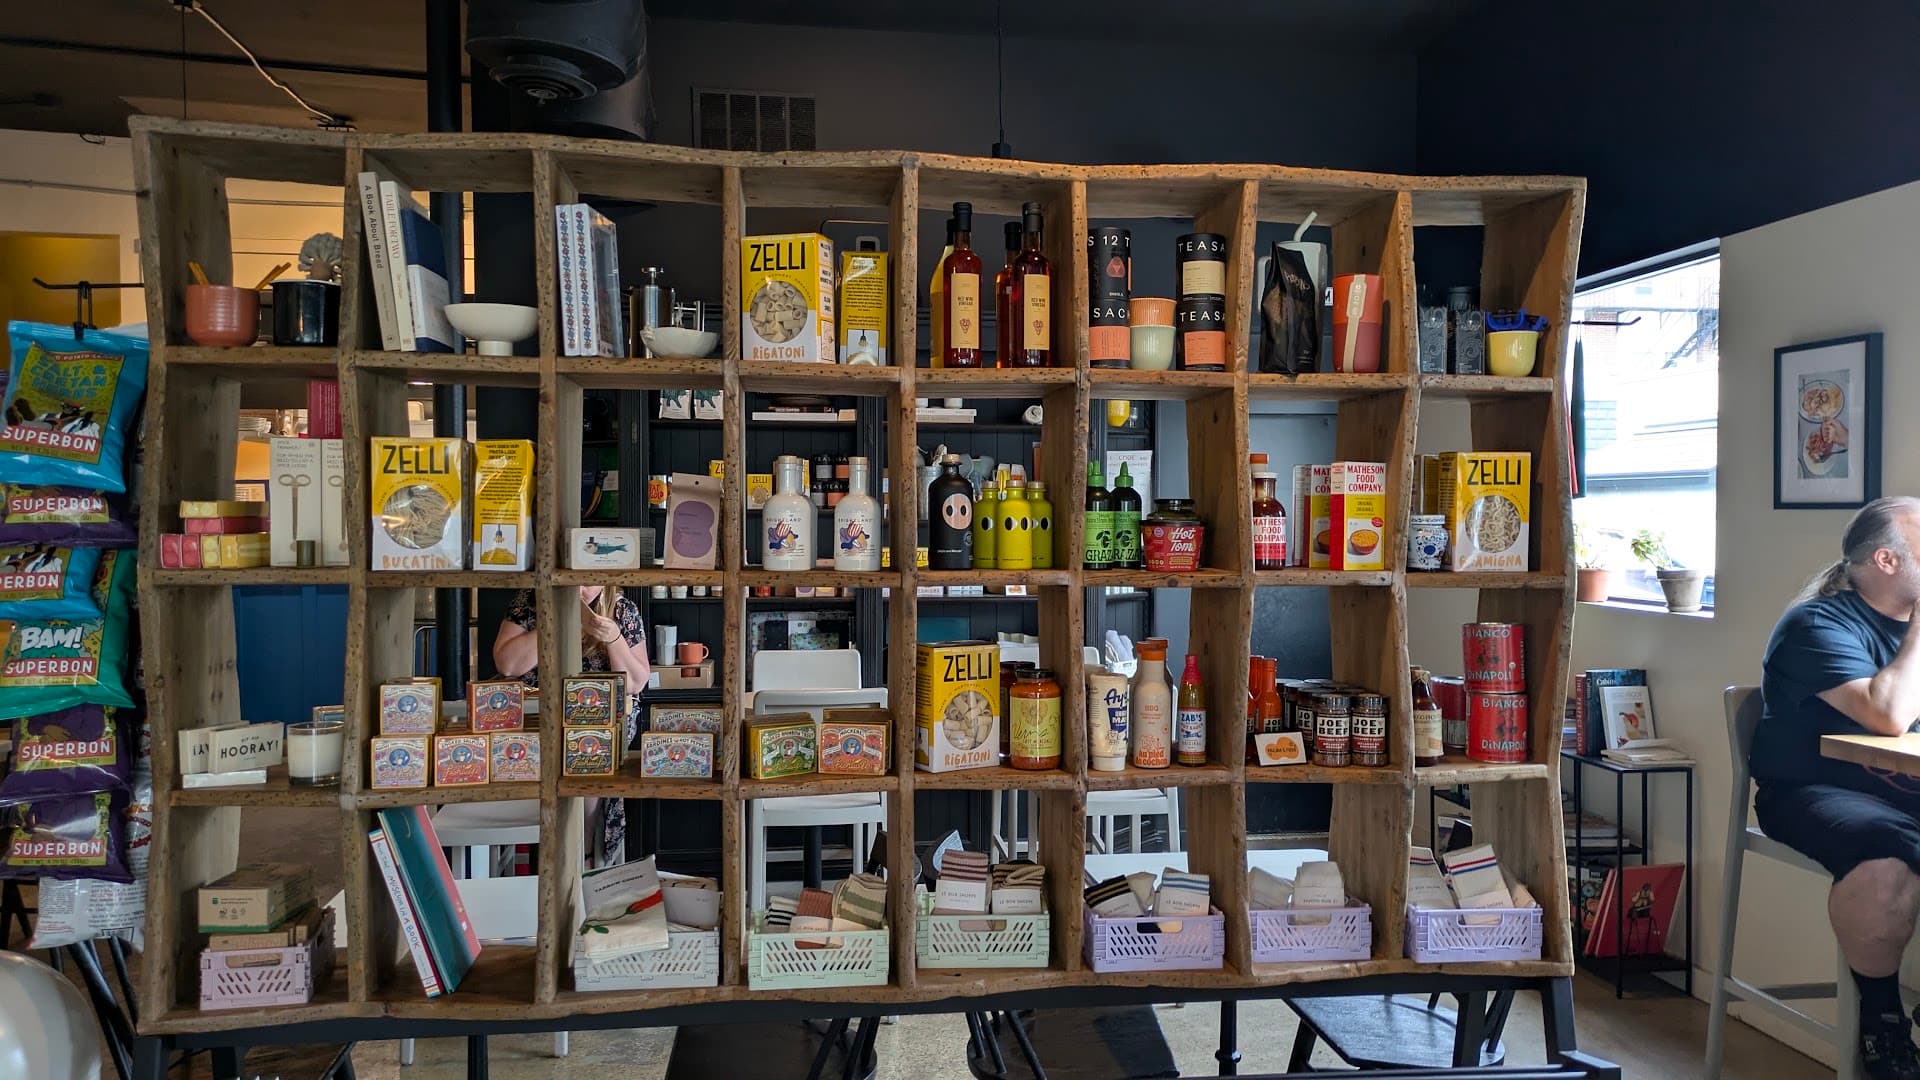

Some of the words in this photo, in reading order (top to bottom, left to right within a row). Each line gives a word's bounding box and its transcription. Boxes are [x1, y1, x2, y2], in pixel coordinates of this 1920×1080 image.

[366, 193, 375, 215] Book
[385, 194, 395, 220] TABLE
[369, 217, 379, 244] About
[1102, 235, 1118, 246] 12
[374, 245, 384, 269] Bread
[750, 241, 806, 272] ZELLI
[1093, 307, 1130, 318] SAC
[39, 355, 82, 378] SALT
[30, 365, 108, 388] CRETAN
[2, 427, 97, 452] SUPERBON
[383, 444, 450, 475] ZELLI
[1347, 464, 1384, 474] MATHESON
[1467, 459, 1522, 486] ZELLI
[1356, 473, 1375, 483] FOOD
[12, 498, 104, 511] SUPERBON
[1172, 527, 1196, 540] Hot
[1261, 526, 1282, 534] FOOD
[20, 626, 83, 651] BAM!
[1464, 629, 1511, 638] BIANCO
[5, 660, 93, 674] SUPERBON
[944, 653, 993, 682] ZELLI
[1482, 698, 1525, 709] BIANCO
[1181, 713, 1202, 722] ZAB'S
[1319, 719, 1343, 727] JOE
[1354, 719, 1377, 727] JOE
[1318, 727, 1348, 735] BEEF
[1353, 727, 1384, 735] BEEF
[22, 740, 111, 759] SUPERBON
[220, 740, 278, 759] HOORAY!
[13, 841, 102, 856] SUPERBON
[388, 875, 403, 905] MUSEUM
[405, 925, 421, 950] BOOK
